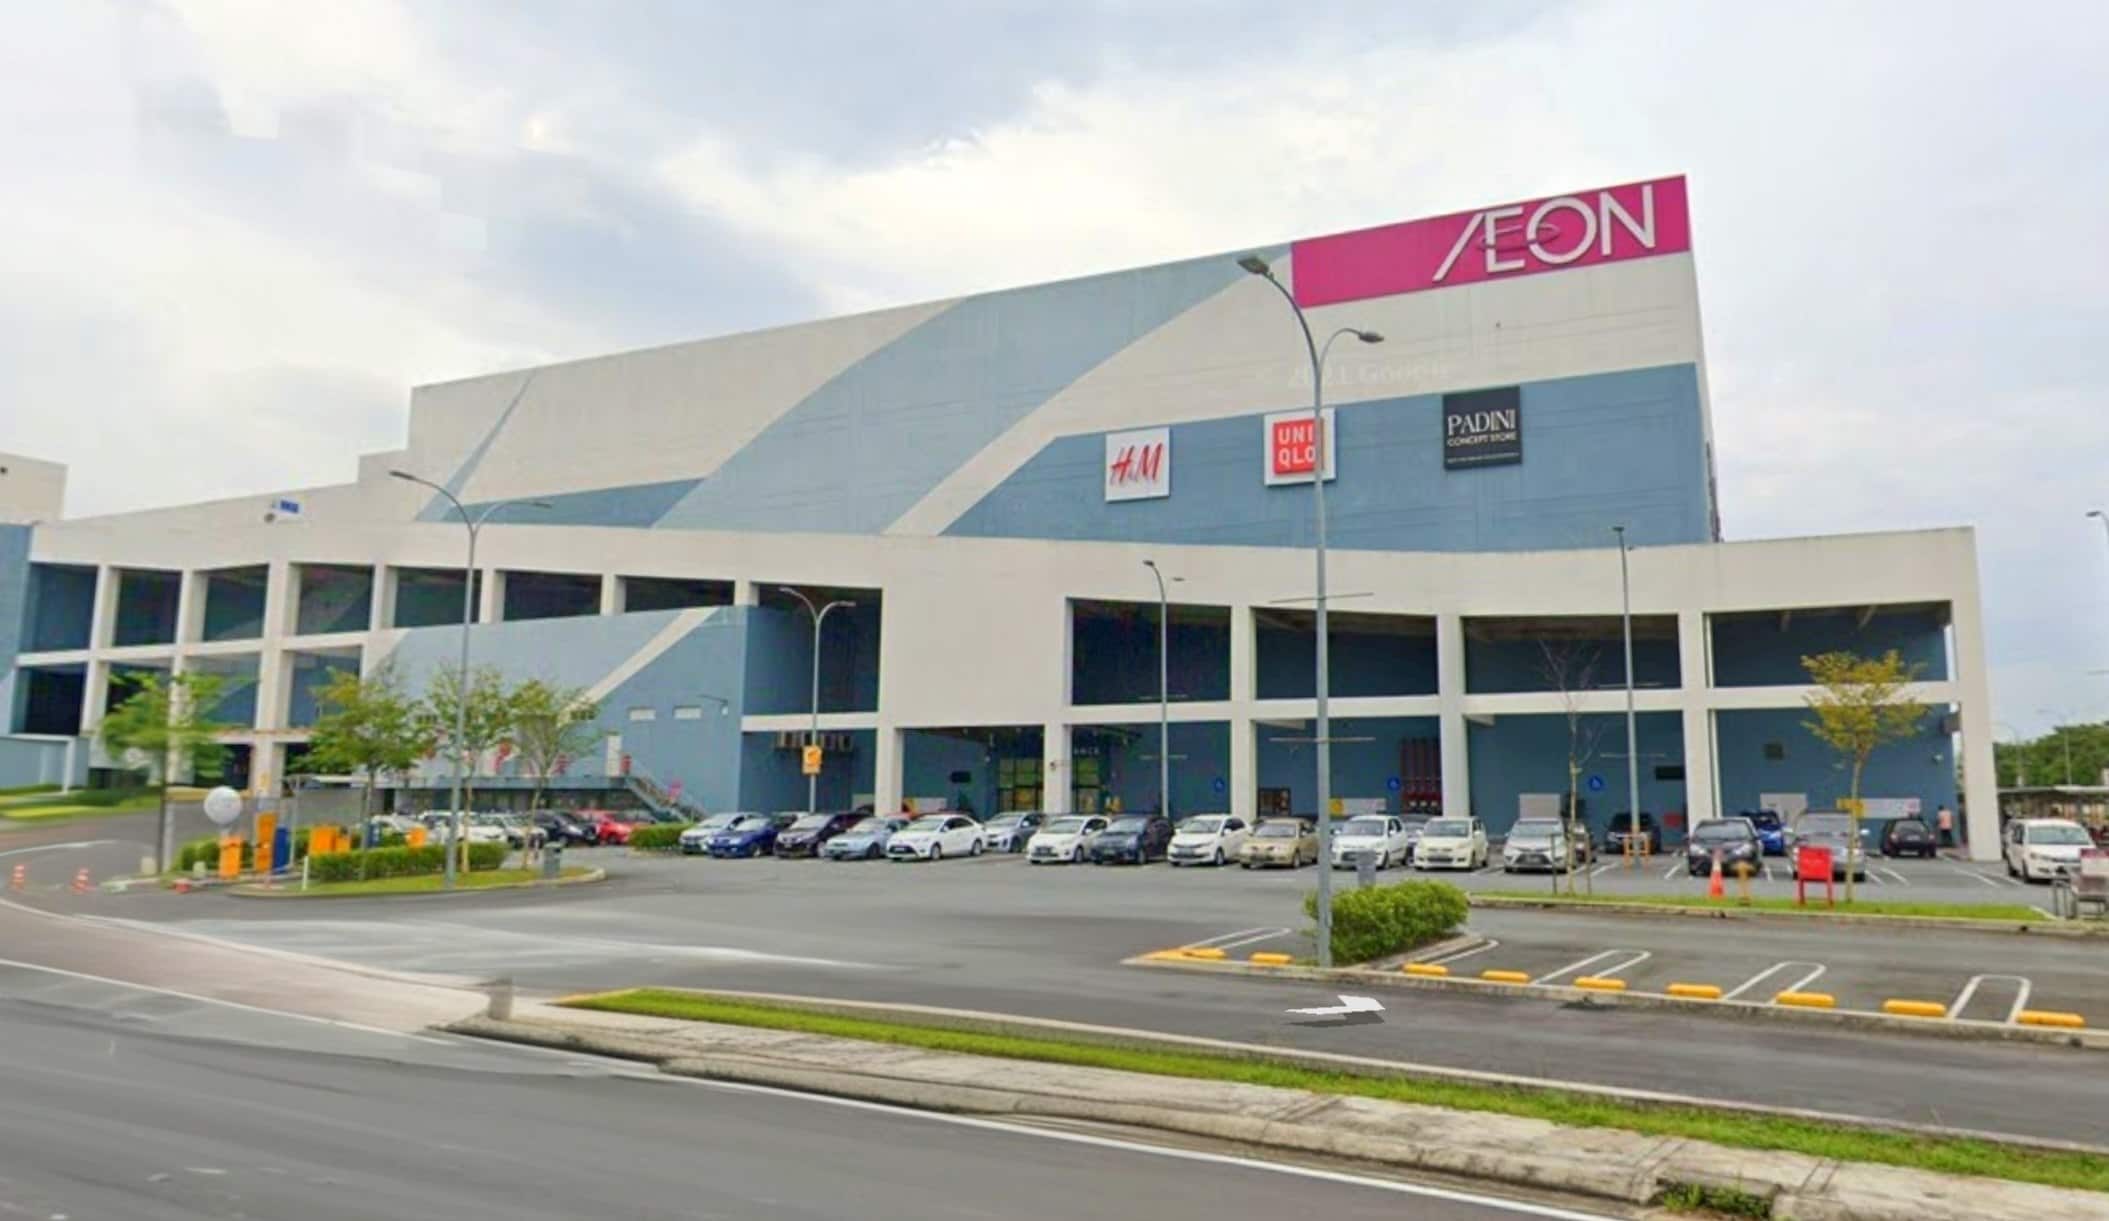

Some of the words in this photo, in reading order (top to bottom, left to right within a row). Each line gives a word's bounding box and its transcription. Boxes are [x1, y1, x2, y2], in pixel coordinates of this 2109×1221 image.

[1278, 423, 1313, 445] UNI
[1447, 409, 1516, 436] PADINI
[1109, 442, 1163, 485] H&M
